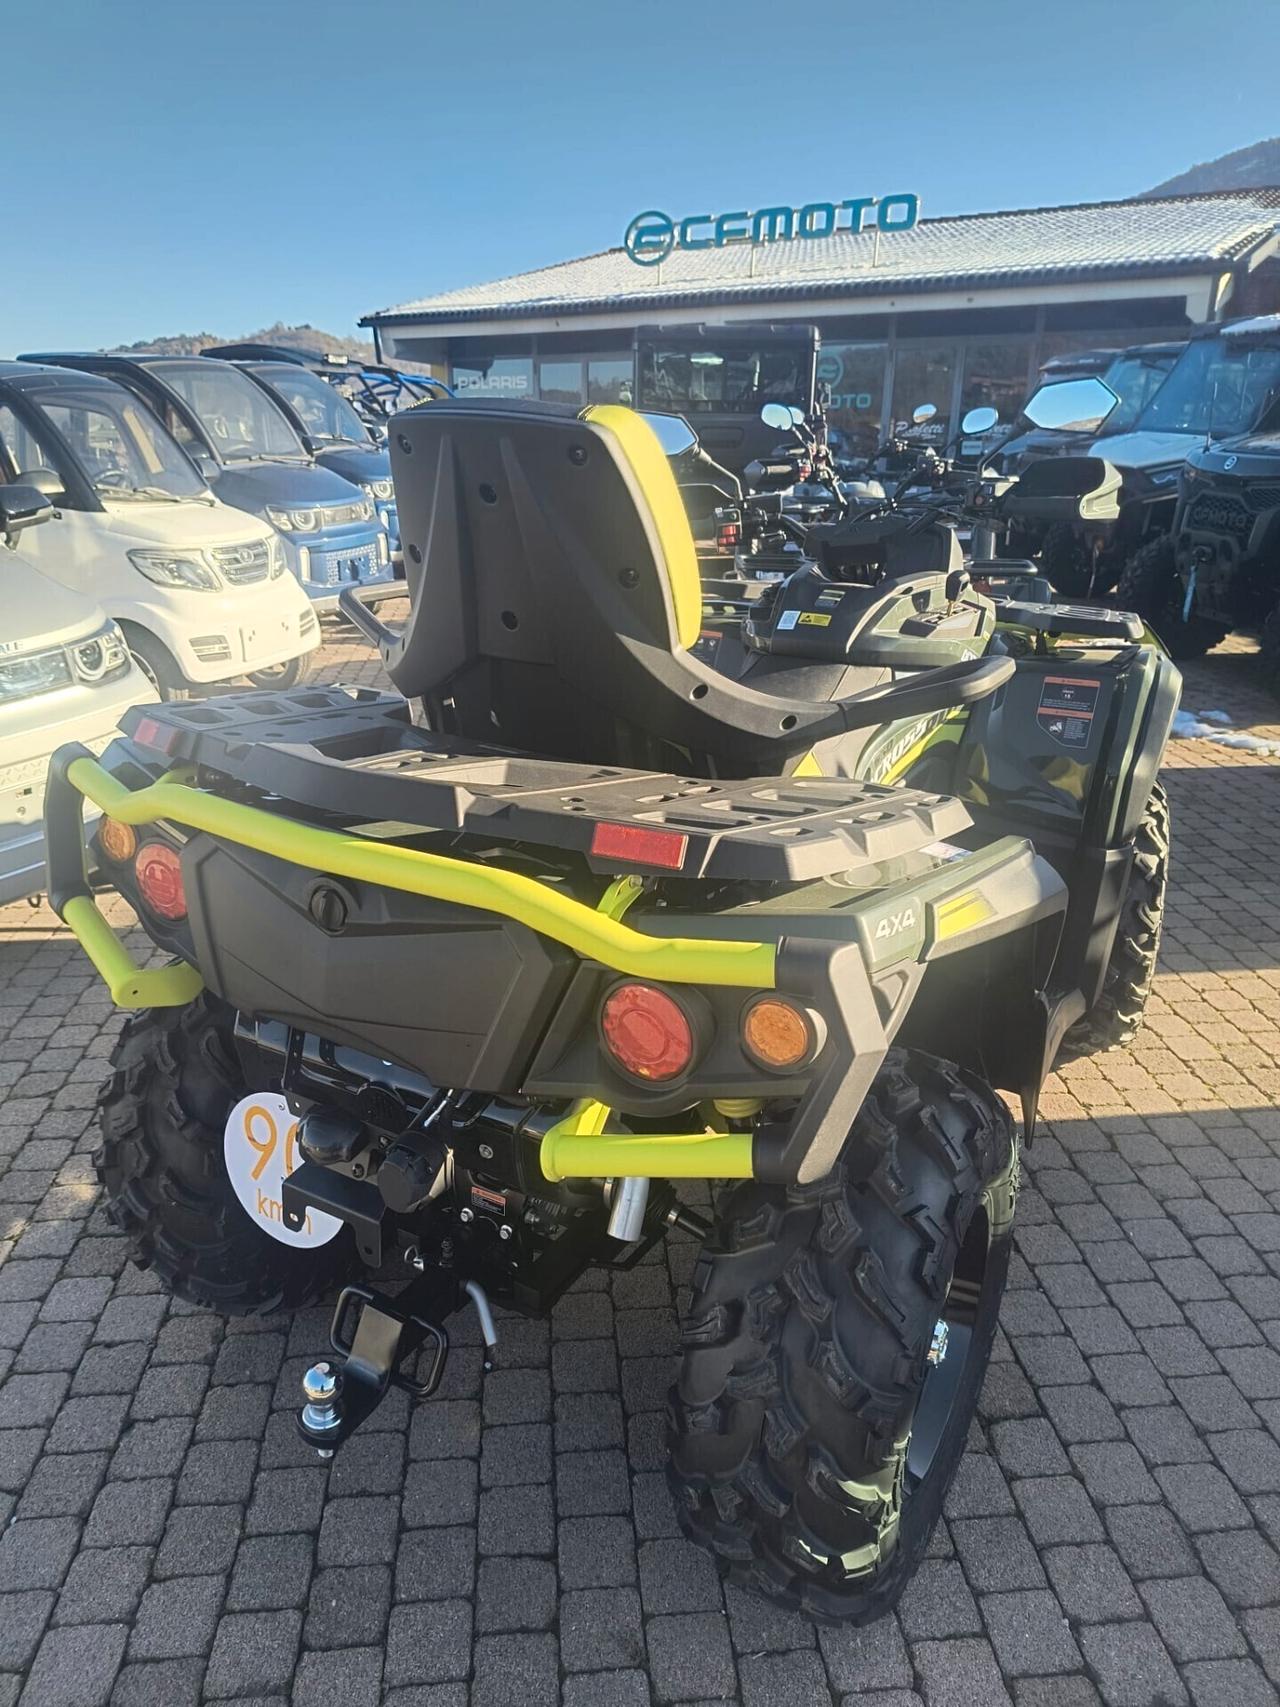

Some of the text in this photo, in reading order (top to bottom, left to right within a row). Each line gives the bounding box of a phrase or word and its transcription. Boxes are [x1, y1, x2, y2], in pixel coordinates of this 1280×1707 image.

[680, 193, 918, 251] CFMOTO
[457, 375, 528, 390] POLARIS
[830, 393, 871, 409] OTO
[875, 909, 916, 938] 4X4
